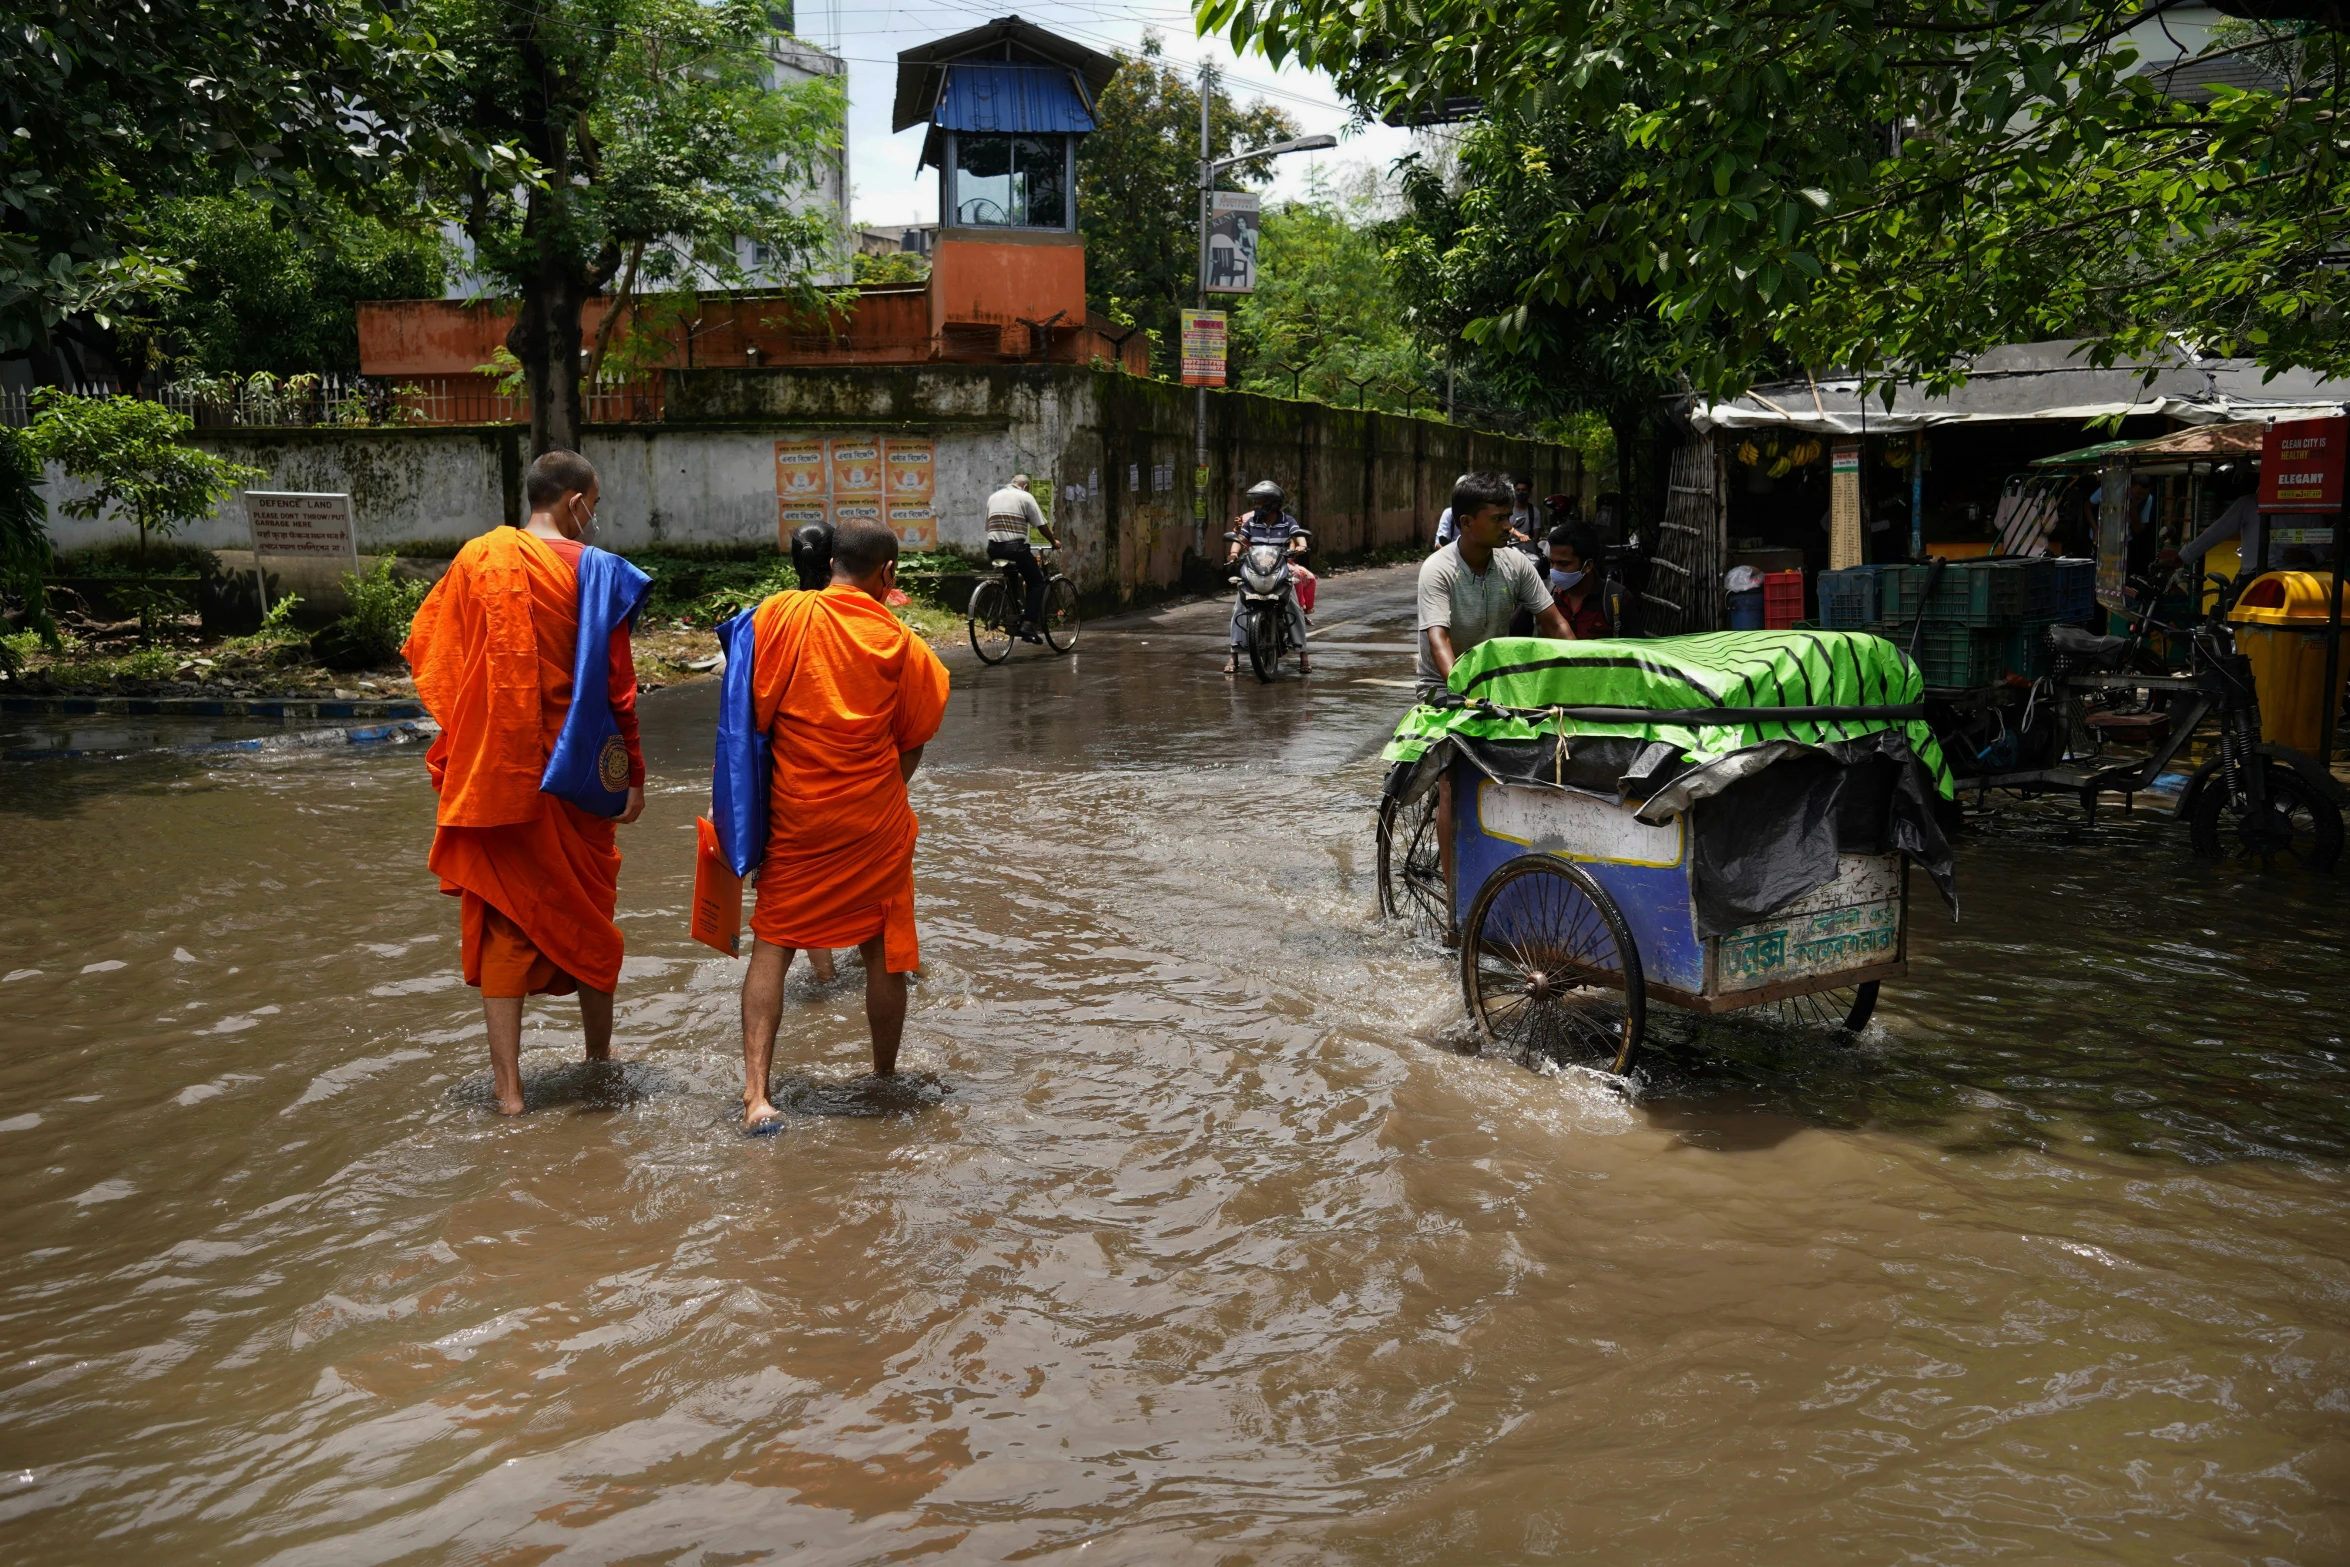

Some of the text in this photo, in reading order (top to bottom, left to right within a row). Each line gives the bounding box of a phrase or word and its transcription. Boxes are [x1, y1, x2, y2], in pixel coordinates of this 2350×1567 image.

[1212, 211, 1236, 228] KENT
[2282, 438, 2326, 449] CLEAN CITY IS
[798, 454, 818, 462] বিজেপি
[854, 450, 874, 458] বিজেপি
[908, 454, 928, 462] বিজেপি
[2281, 450, 2308, 460] HEALTHY
[2278, 473, 2324, 484] ELEGANT
[260, 500, 332, 509] DEFENCE LAND
[801, 512, 820, 520] বিজেপি
[856, 508, 876, 516] বিজেপি
[909, 510, 930, 518] বিজেপি
